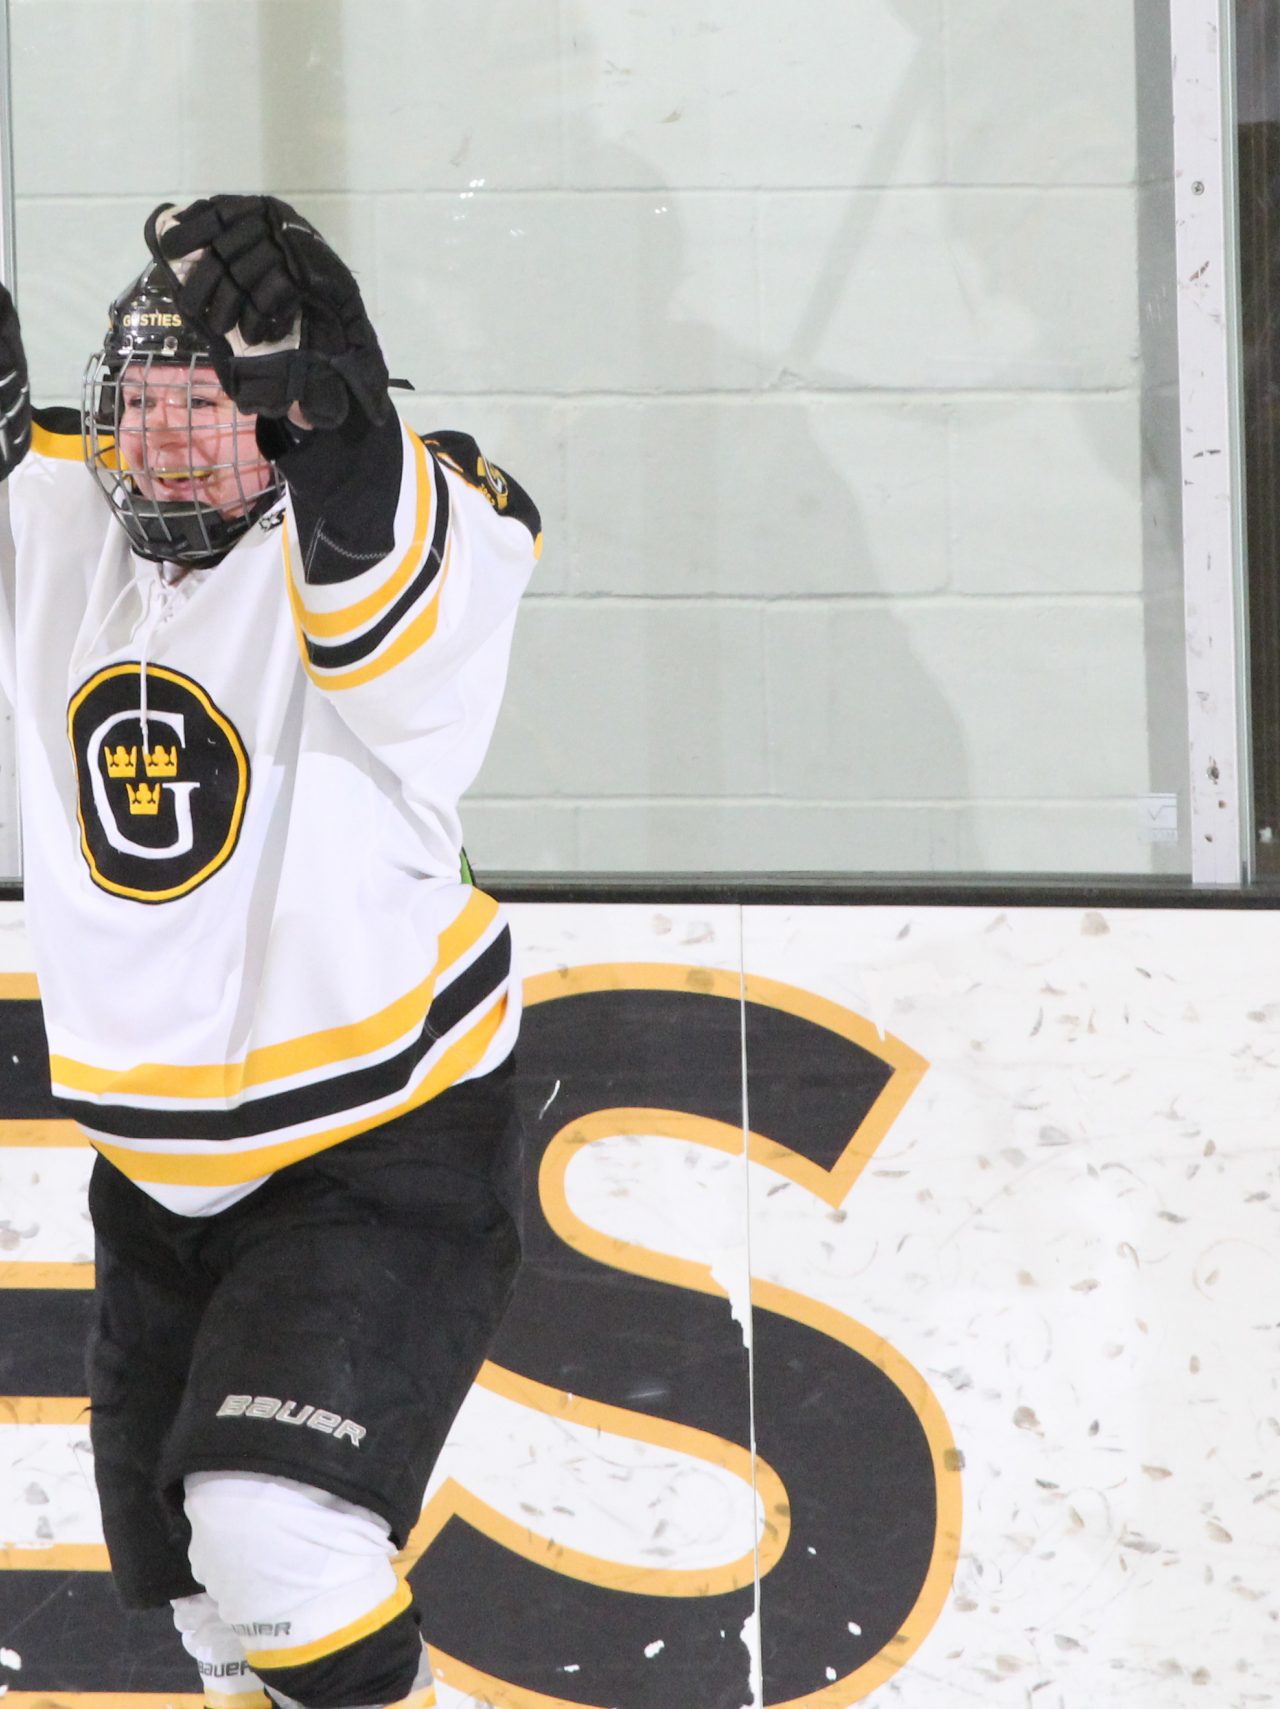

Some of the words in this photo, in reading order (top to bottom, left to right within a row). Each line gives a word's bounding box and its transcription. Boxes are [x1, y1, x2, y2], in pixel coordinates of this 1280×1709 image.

[123, 314, 183, 328] GSTIES
[86, 708, 201, 860] G
[215, 1394, 367, 1449] BAUER
